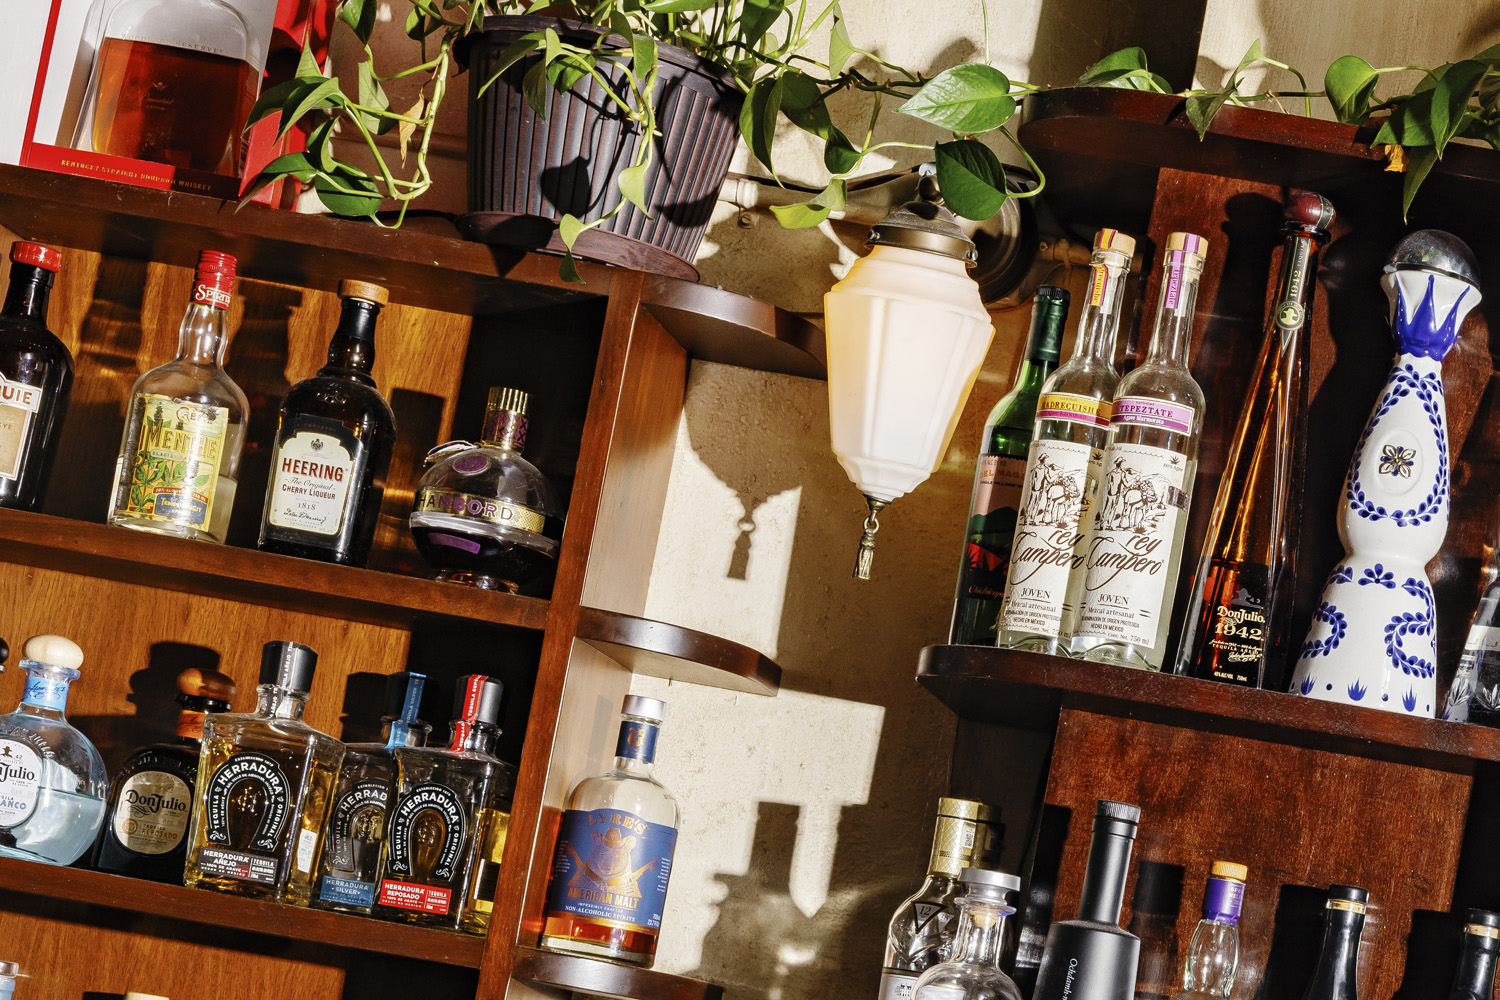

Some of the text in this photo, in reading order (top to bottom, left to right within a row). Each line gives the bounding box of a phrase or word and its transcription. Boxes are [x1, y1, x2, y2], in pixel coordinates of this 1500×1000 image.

[1120, 404, 1174, 418] TEPEZTATE
[145, 419, 217, 459] MENTHE
[282, 457, 344, 482] HEERING
[282, 484, 336, 500] CHERRY LIQUEUR
[1020, 587, 1051, 600] JOVEN
[1098, 593, 1130, 605] JOVEN
[1214, 622, 1262, 641] 1942
[217, 762, 283, 795] HERRADURA
[401, 792, 459, 823] HERRADURA
[267, 804, 283, 837] ORIGINAL
[588, 812, 648, 834] LYRE'S
[203, 849, 249, 863] HERRADURA
[213, 856, 237, 867] AÑEJO
[326, 878, 369, 891] HERRADURA
[384, 883, 425, 895] HERRADURA
[387, 890, 420, 900] REPOSADO
[567, 887, 639, 909] AMERICAN MALT
[565, 905, 635, 922] NON-ALCOHOLIC SPIRITS
